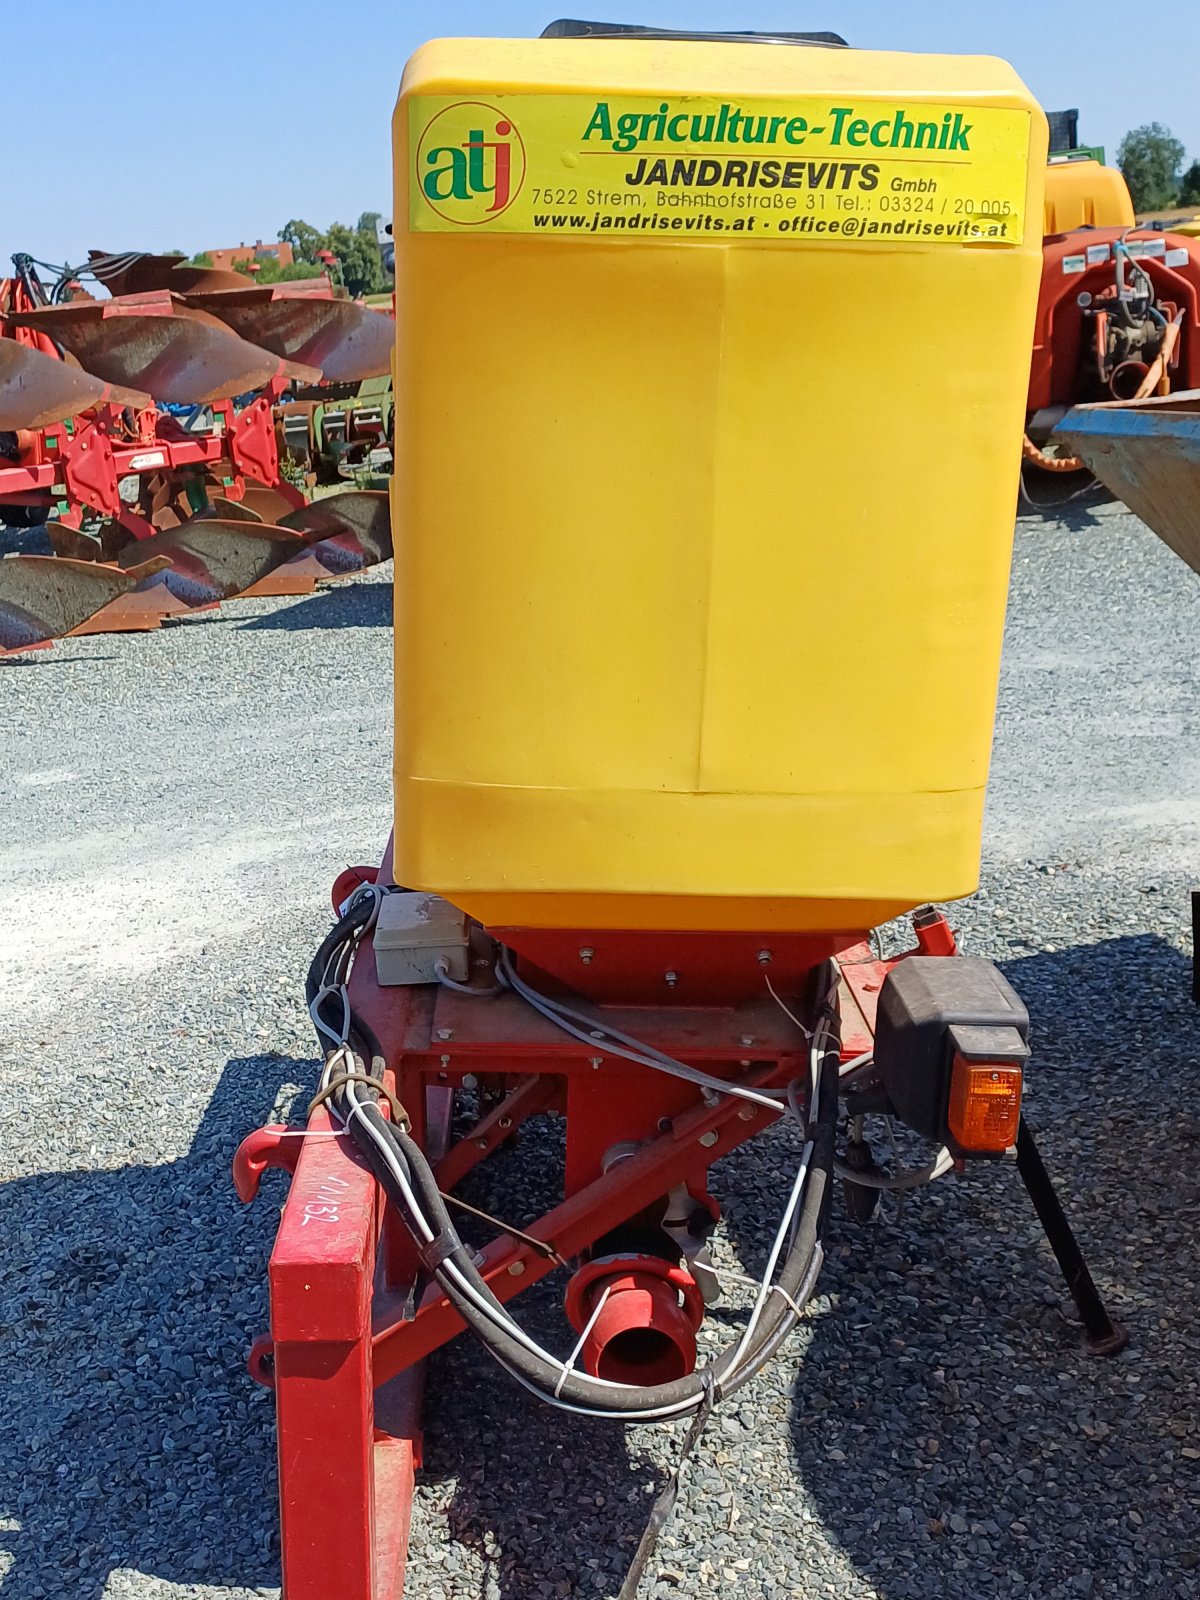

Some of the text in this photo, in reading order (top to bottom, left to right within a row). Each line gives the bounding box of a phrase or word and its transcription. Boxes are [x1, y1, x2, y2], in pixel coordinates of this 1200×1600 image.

[581, 102, 973, 152] Agriculture-Technik
[423, 120, 512, 213] atj
[625, 158, 937, 193] JANDRISEVITS Gmbh
[532, 189, 578, 205] 7522
[586, 189, 648, 209] Strem,
[657, 190, 797, 210] Bahnhofstraße
[805, 194, 825, 210] 31
[879, 195, 934, 213] 03324
[954, 198, 975, 215] 20
[980, 200, 1012, 216] 005
[533, 212, 755, 232] www.jandrisevits.at
[778, 216, 1008, 237] office@jandrisevits.at
